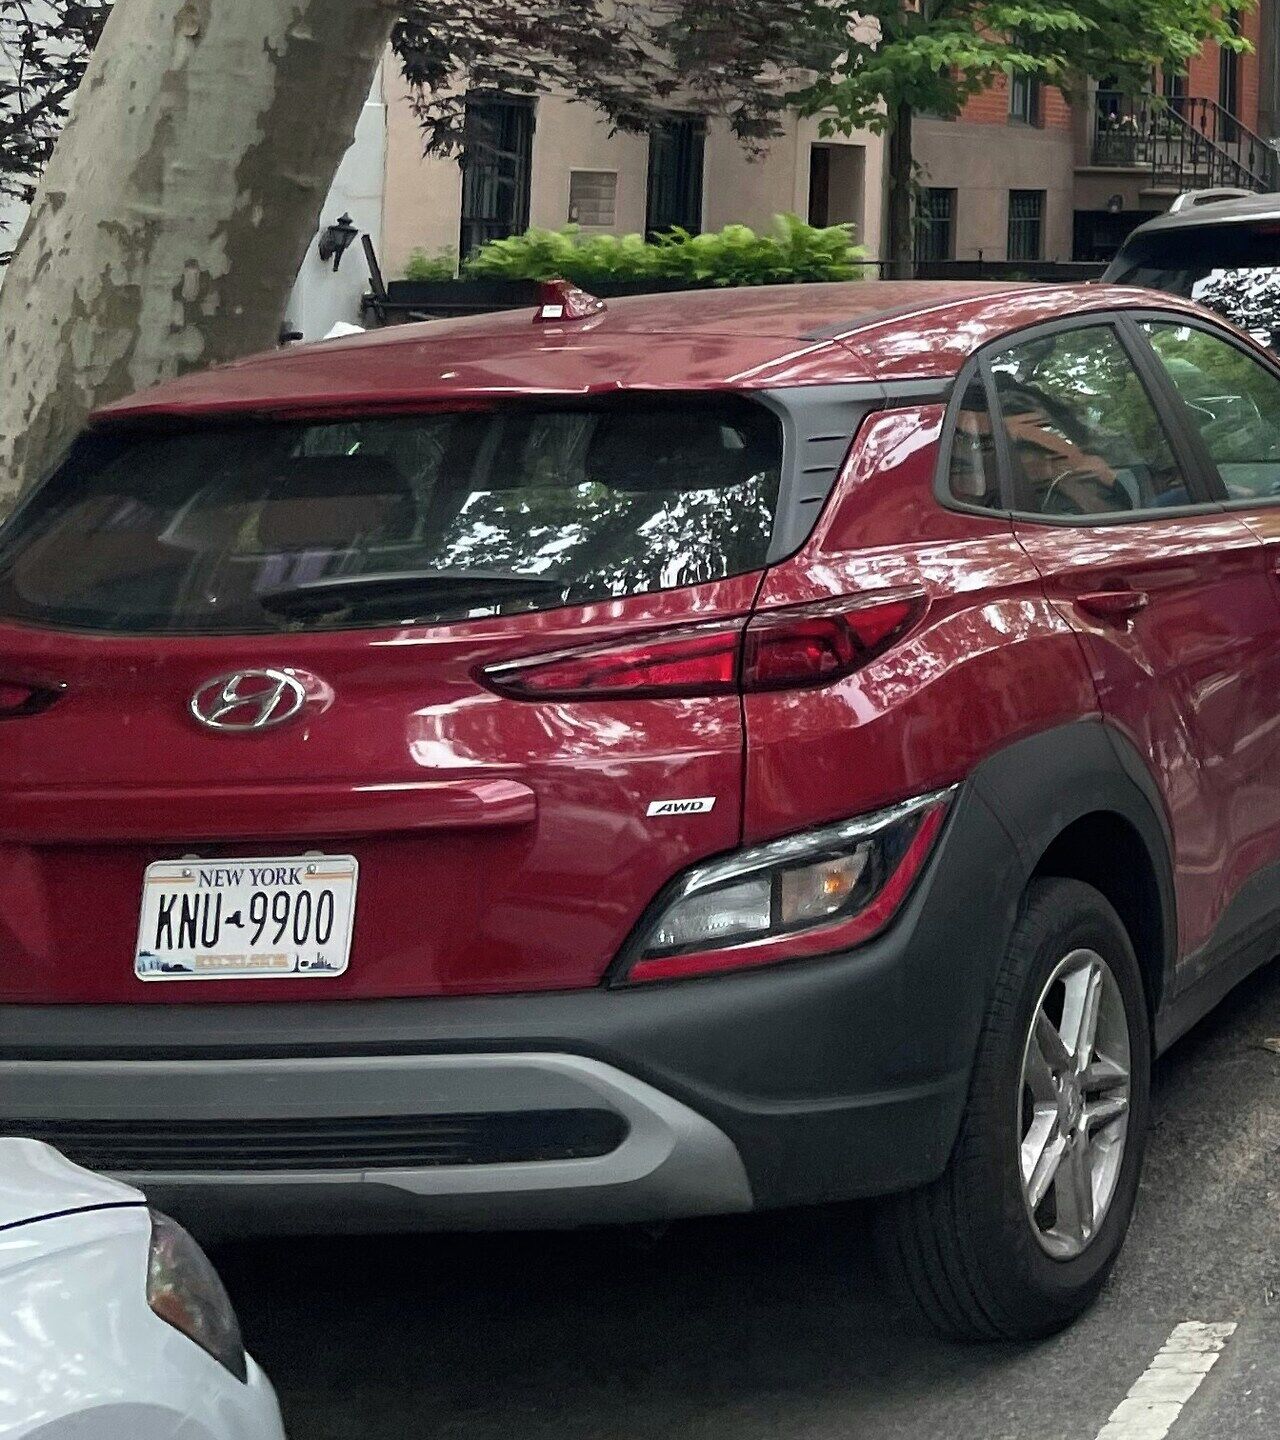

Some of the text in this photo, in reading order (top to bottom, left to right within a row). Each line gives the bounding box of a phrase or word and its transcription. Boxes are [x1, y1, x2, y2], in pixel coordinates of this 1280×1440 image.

[656, 801, 703, 814] AWD
[198, 866, 302, 888] NEW YORK
